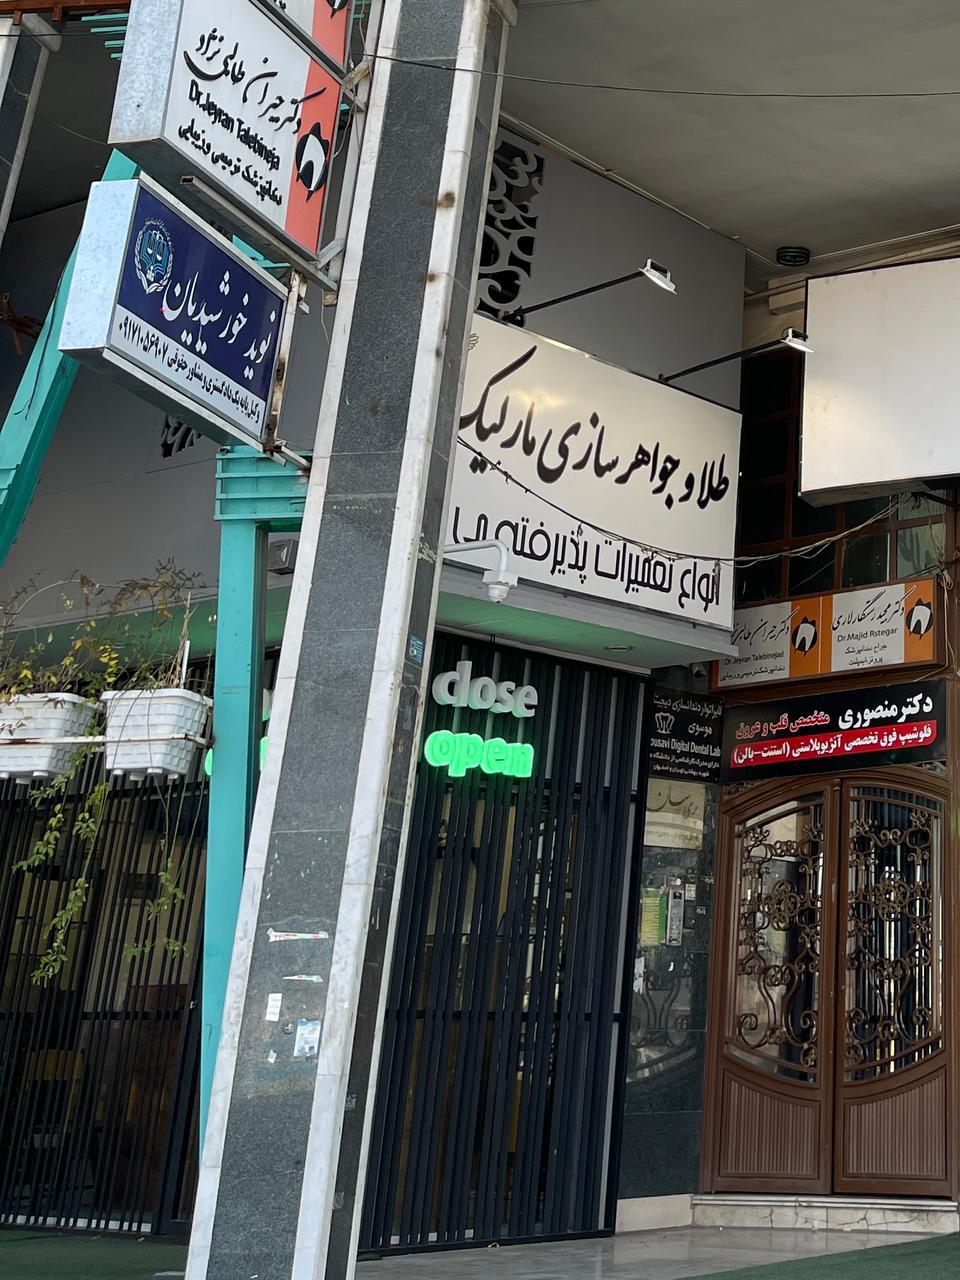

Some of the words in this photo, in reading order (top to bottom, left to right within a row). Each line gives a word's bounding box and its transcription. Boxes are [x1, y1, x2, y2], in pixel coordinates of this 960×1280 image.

[274, 87, 328, 134] دکتر
[242, 311, 277, 381] نوید
[677, 471, 697, 504] و
[697, 452, 731, 511] طلا
[432, 661, 538, 718] close
[838, 698, 899, 730] منصوری
[896, 693, 934, 723] دکتر
[688, 722, 712, 737] موسوی
[735, 720, 761, 740] عروق
[762, 721, 769, 737] و
[769, 712, 789, 734] قلب
[789, 709, 831, 733] متخصص
[791, 732, 843, 758] آنژیوپلاستی
[843, 730, 879, 752] تخصصی
[879, 727, 898, 747] فوق
[898, 723, 932, 746] فلوشیپ
[424, 730, 534, 777] open
[670, 738, 690, 753] Digital
[690, 741, 709, 755] Dental
[709, 744, 721, 757] Lab
